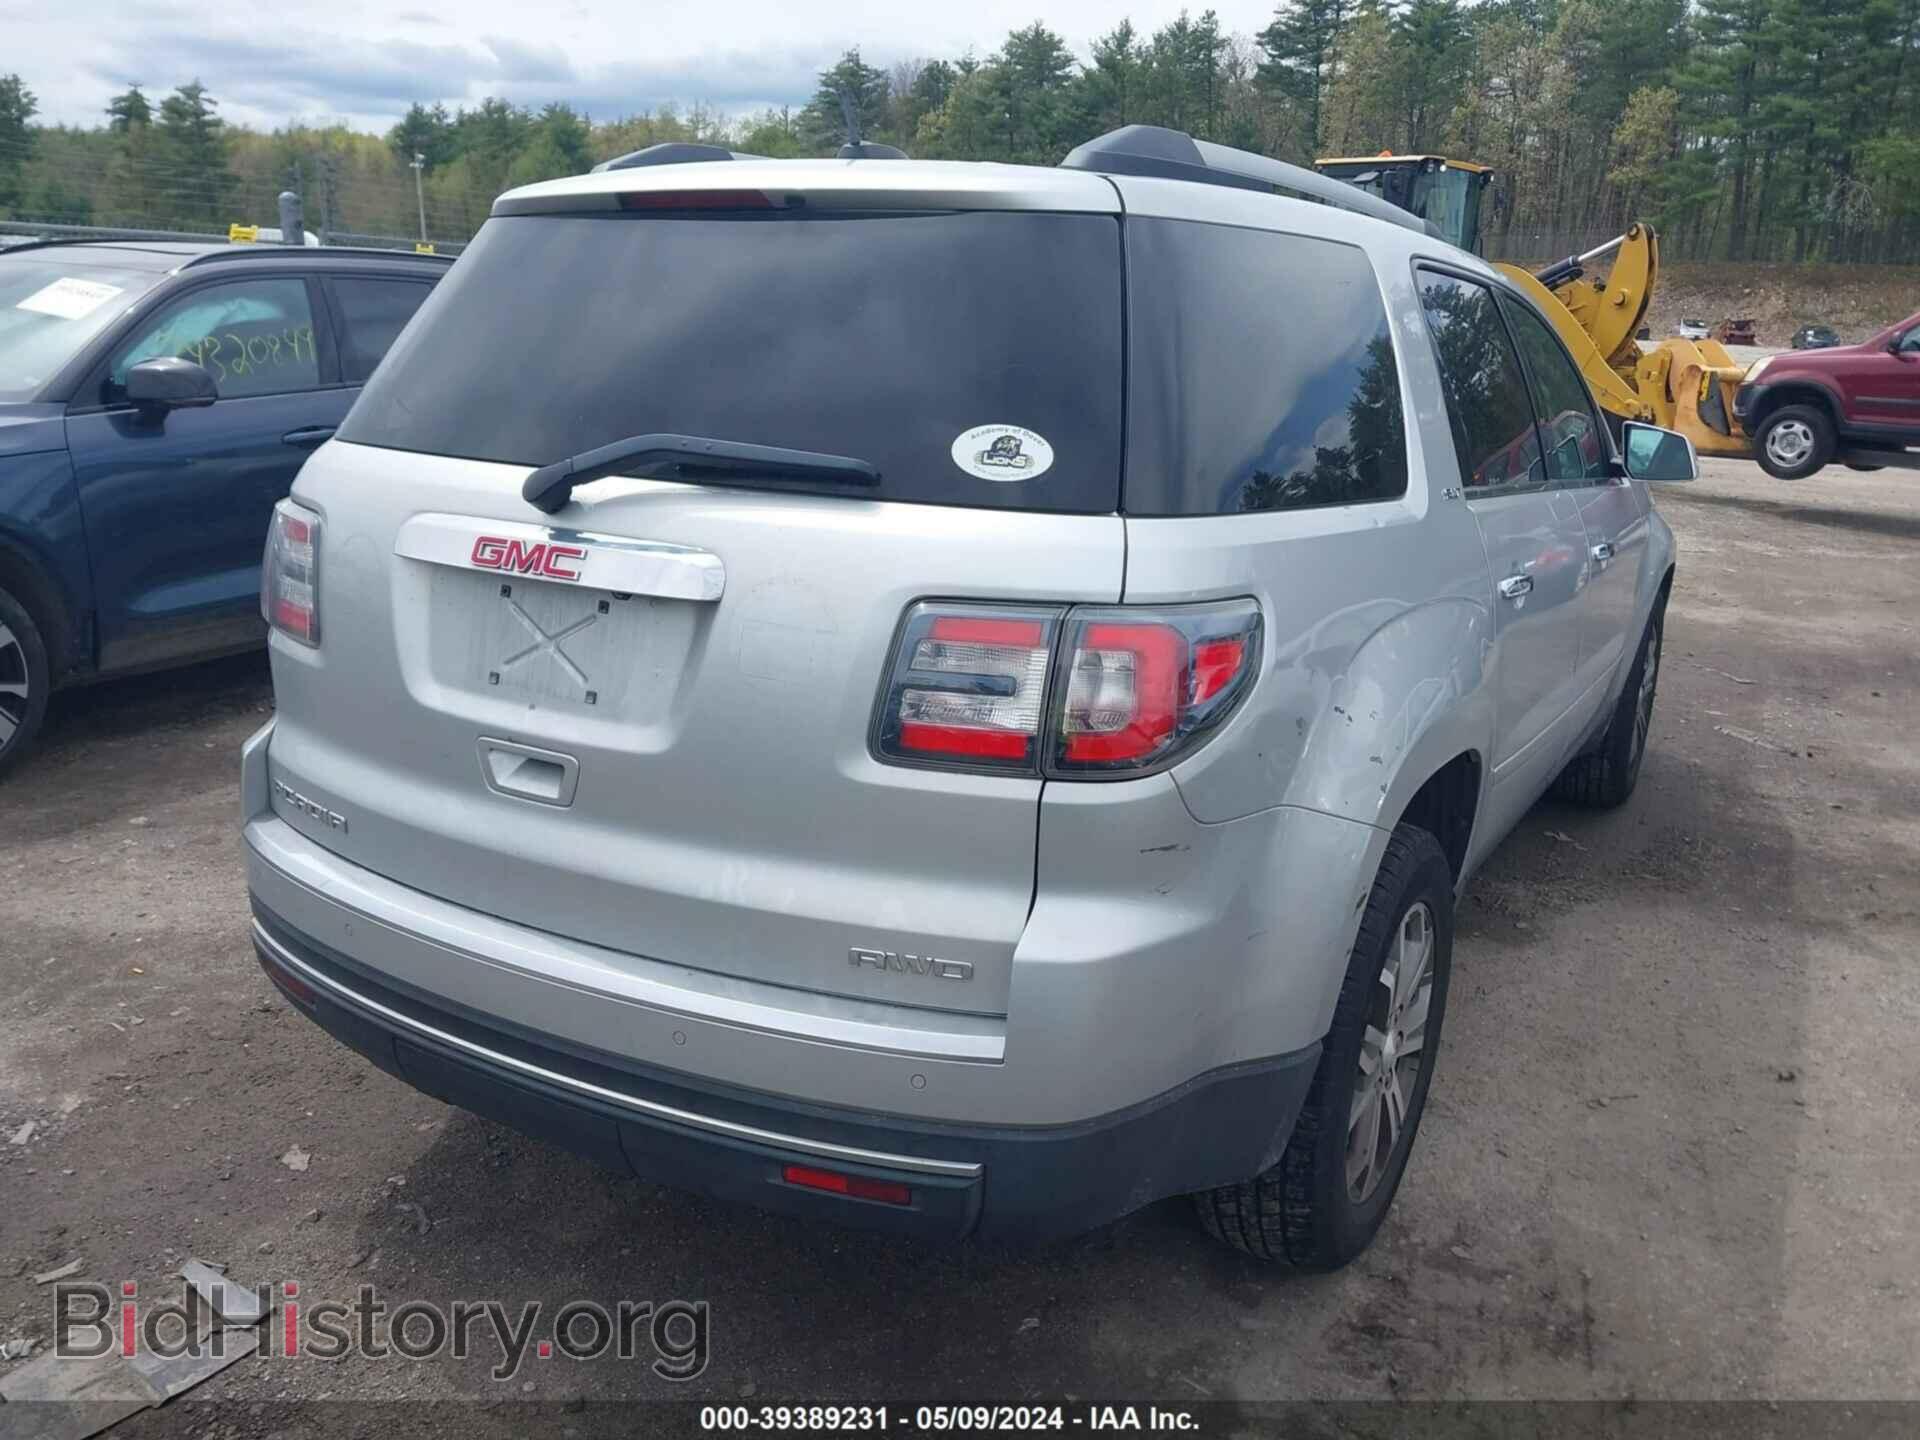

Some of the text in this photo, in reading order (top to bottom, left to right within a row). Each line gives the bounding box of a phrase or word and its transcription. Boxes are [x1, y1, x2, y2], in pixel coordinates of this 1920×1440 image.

[982, 451, 1027, 468] LIONS
[471, 536, 587, 582] GMC
[848, 947, 974, 980] AWD
